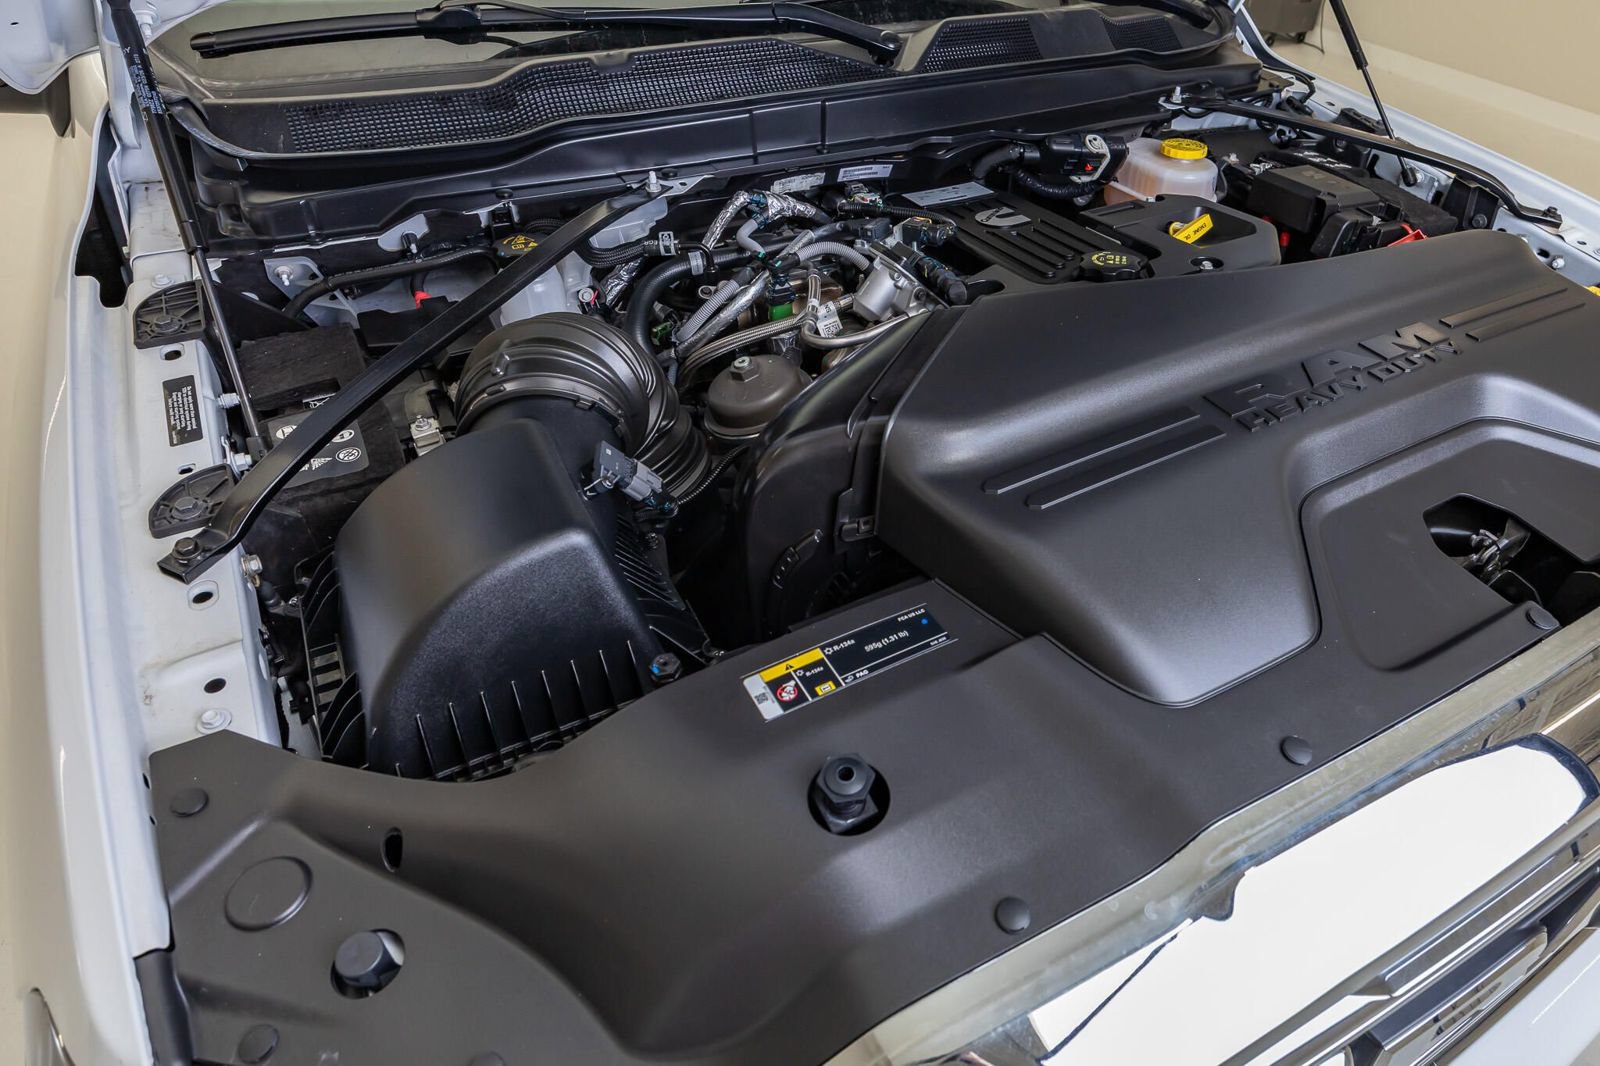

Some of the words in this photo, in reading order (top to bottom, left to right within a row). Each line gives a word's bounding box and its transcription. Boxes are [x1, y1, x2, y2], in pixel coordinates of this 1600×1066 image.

[1202, 322, 1450, 418] RAM
[1235, 374, 1366, 432] HEAVY
[1368, 340, 1462, 382] DUTY
[833, 639, 855, 651] R-134a
[856, 669, 869, 678] PAG
